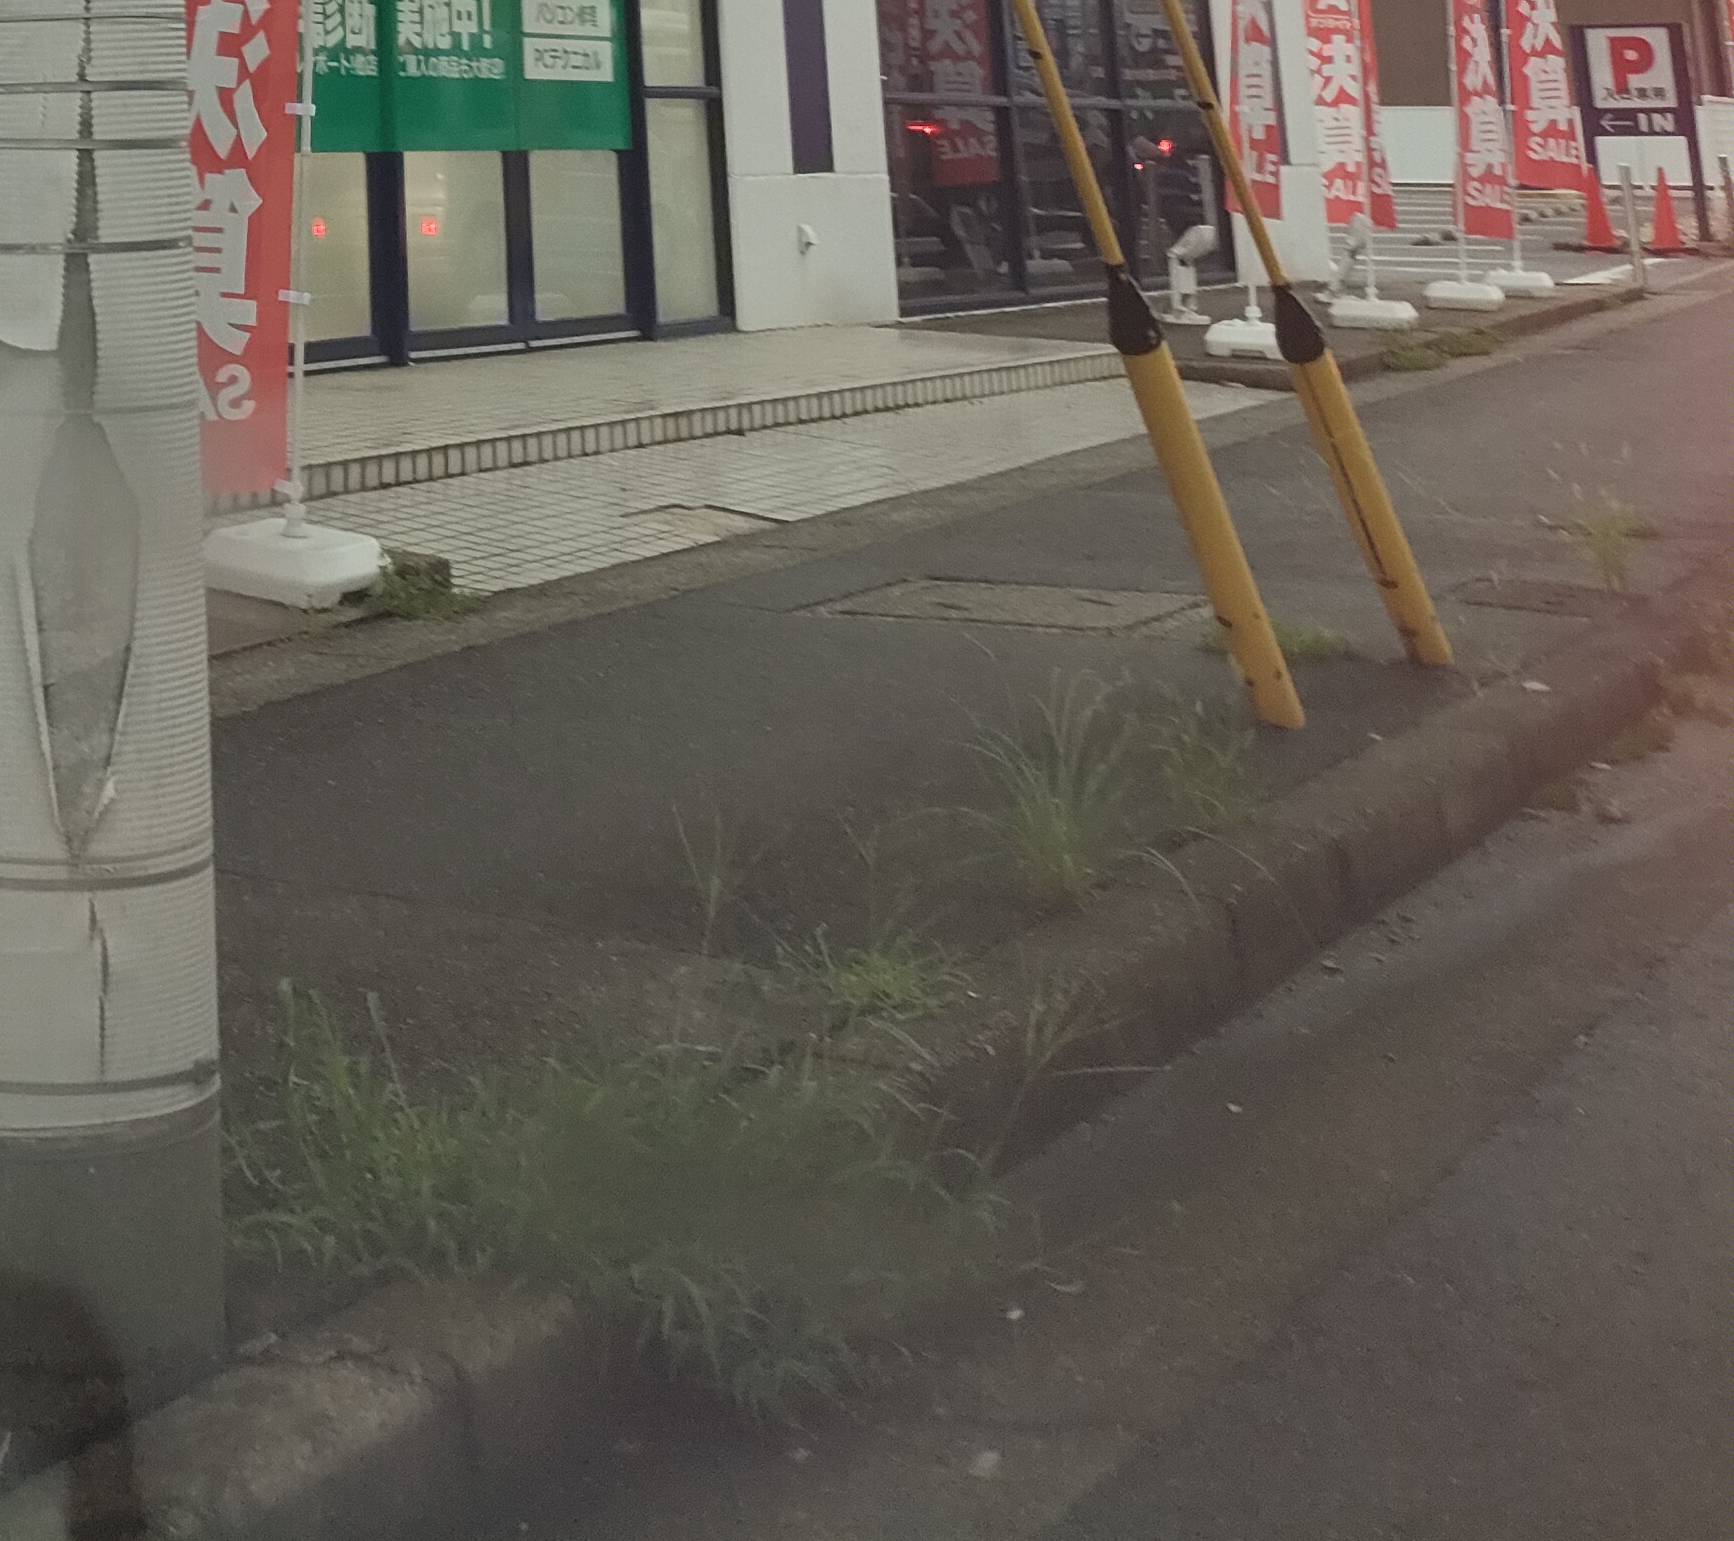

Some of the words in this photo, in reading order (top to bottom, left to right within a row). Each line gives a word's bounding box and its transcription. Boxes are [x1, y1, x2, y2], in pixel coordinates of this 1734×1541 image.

[1607, 35, 1655, 96] P
[1637, 111, 1676, 133] IN
[1526, 136, 1580, 164] SALE
